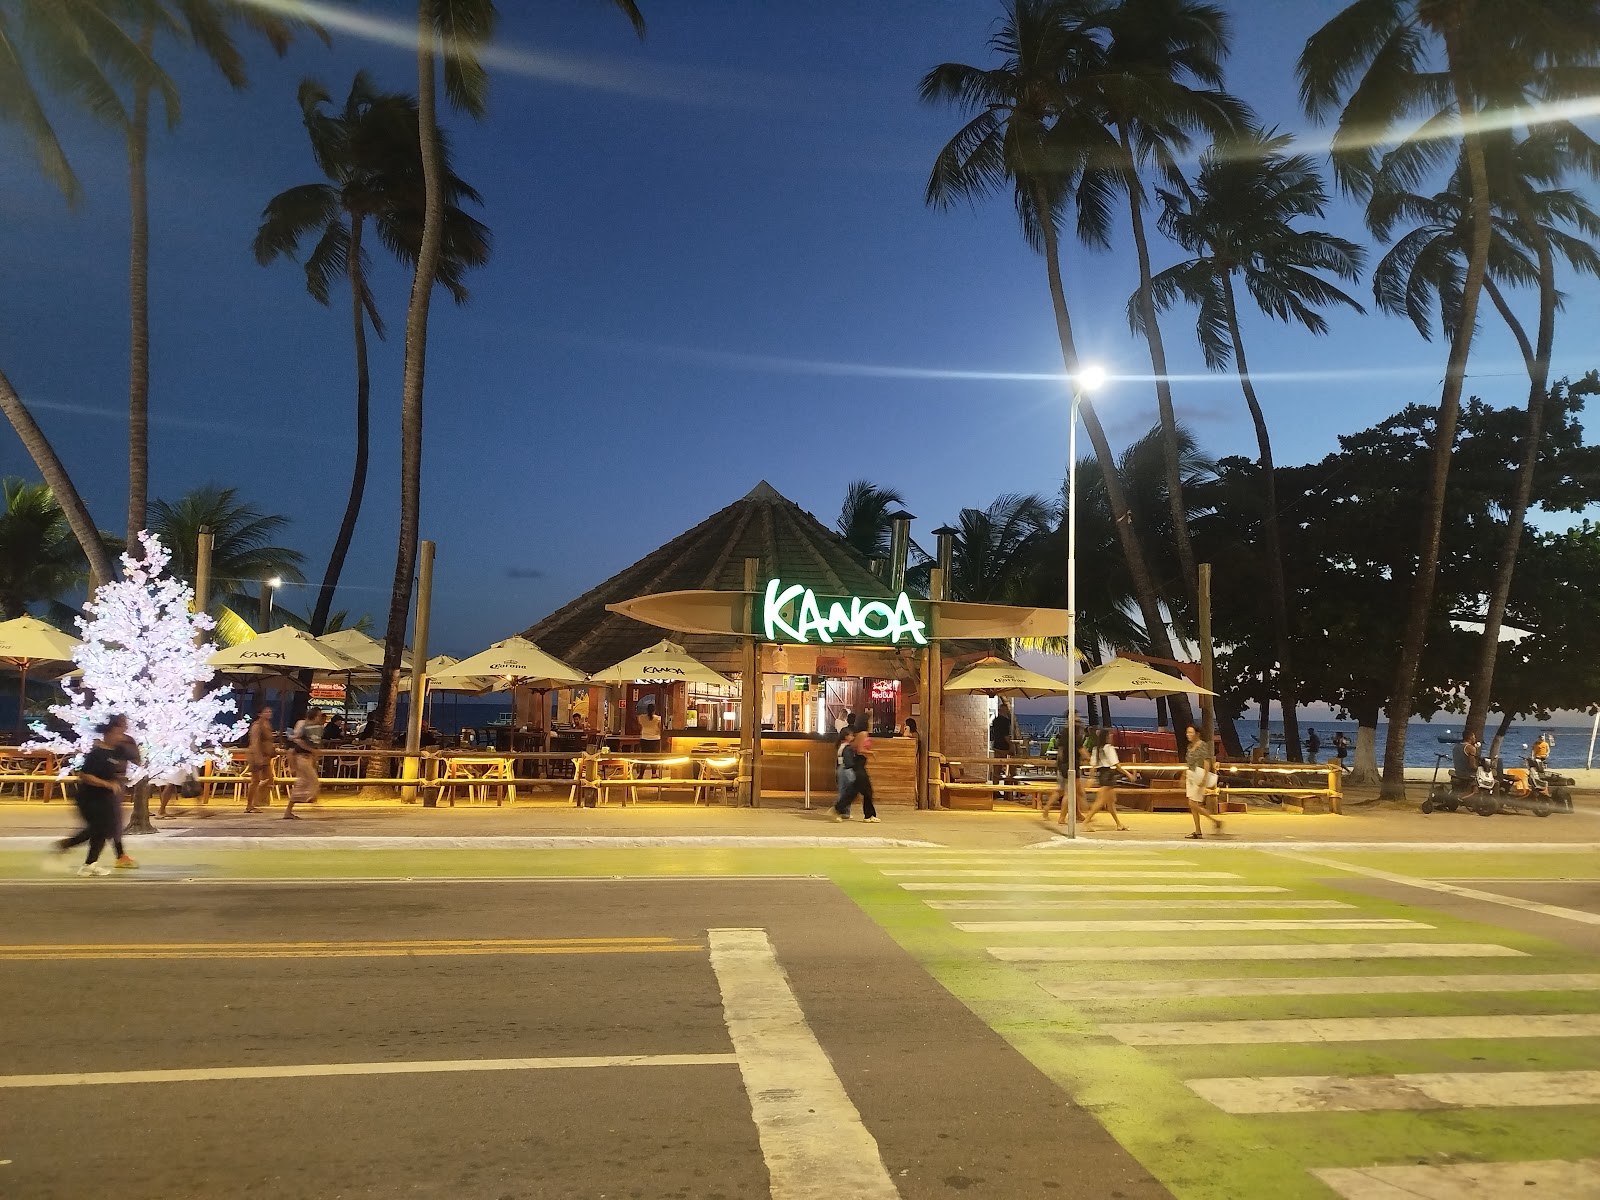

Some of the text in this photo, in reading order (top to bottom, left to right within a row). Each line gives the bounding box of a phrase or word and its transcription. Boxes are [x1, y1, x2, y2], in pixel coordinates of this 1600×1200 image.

[764, 578, 928, 645] KANOA
[239, 651, 287, 660] KANOA
[642, 666, 686, 676] KANOA
[817, 664, 847, 674] Corona
[871, 690, 894, 699] Red Bull
